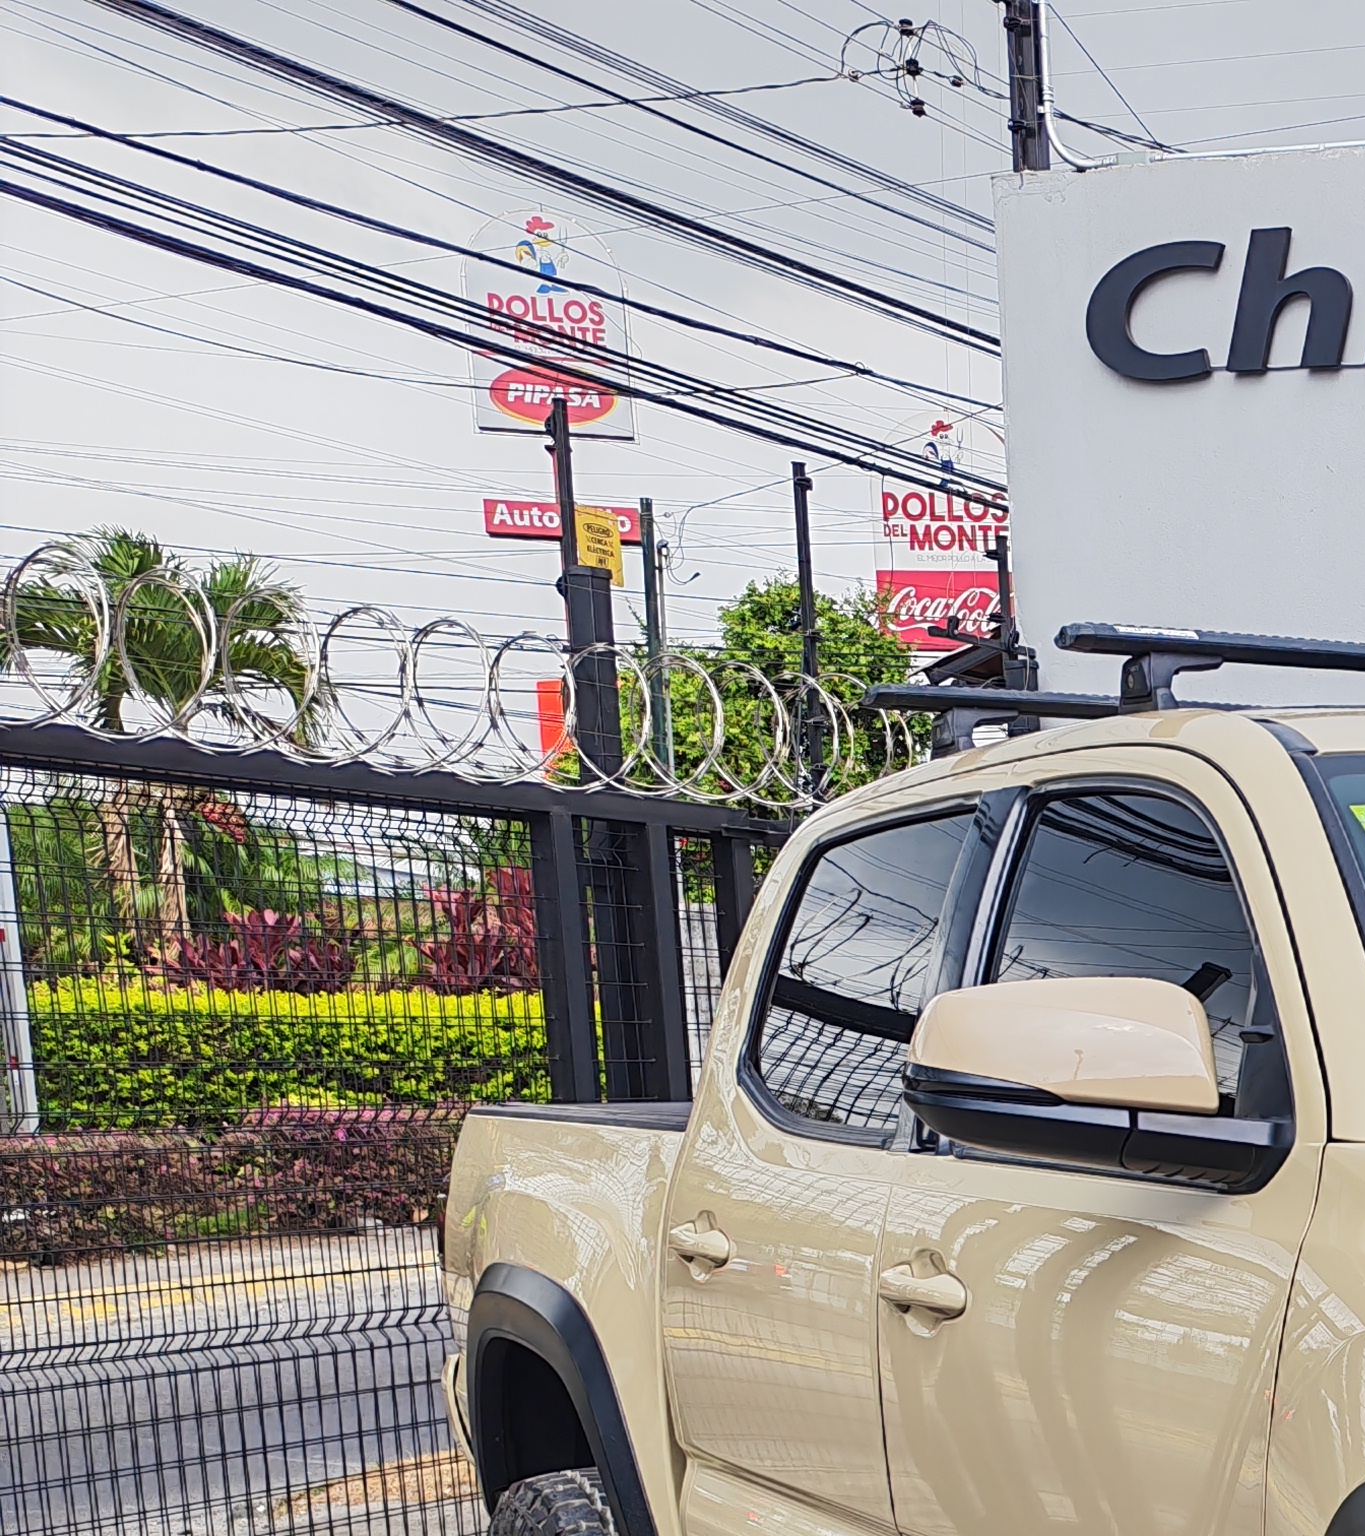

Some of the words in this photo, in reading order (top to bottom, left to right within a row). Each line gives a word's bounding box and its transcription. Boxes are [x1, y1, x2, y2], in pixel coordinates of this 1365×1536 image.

[487, 292, 605, 326] POLLOS
[507, 382, 601, 408] PIPASA
[492, 503, 560, 528] Auto
[882, 492, 1009, 523] POLLOS
[883, 524, 907, 537] DEL
